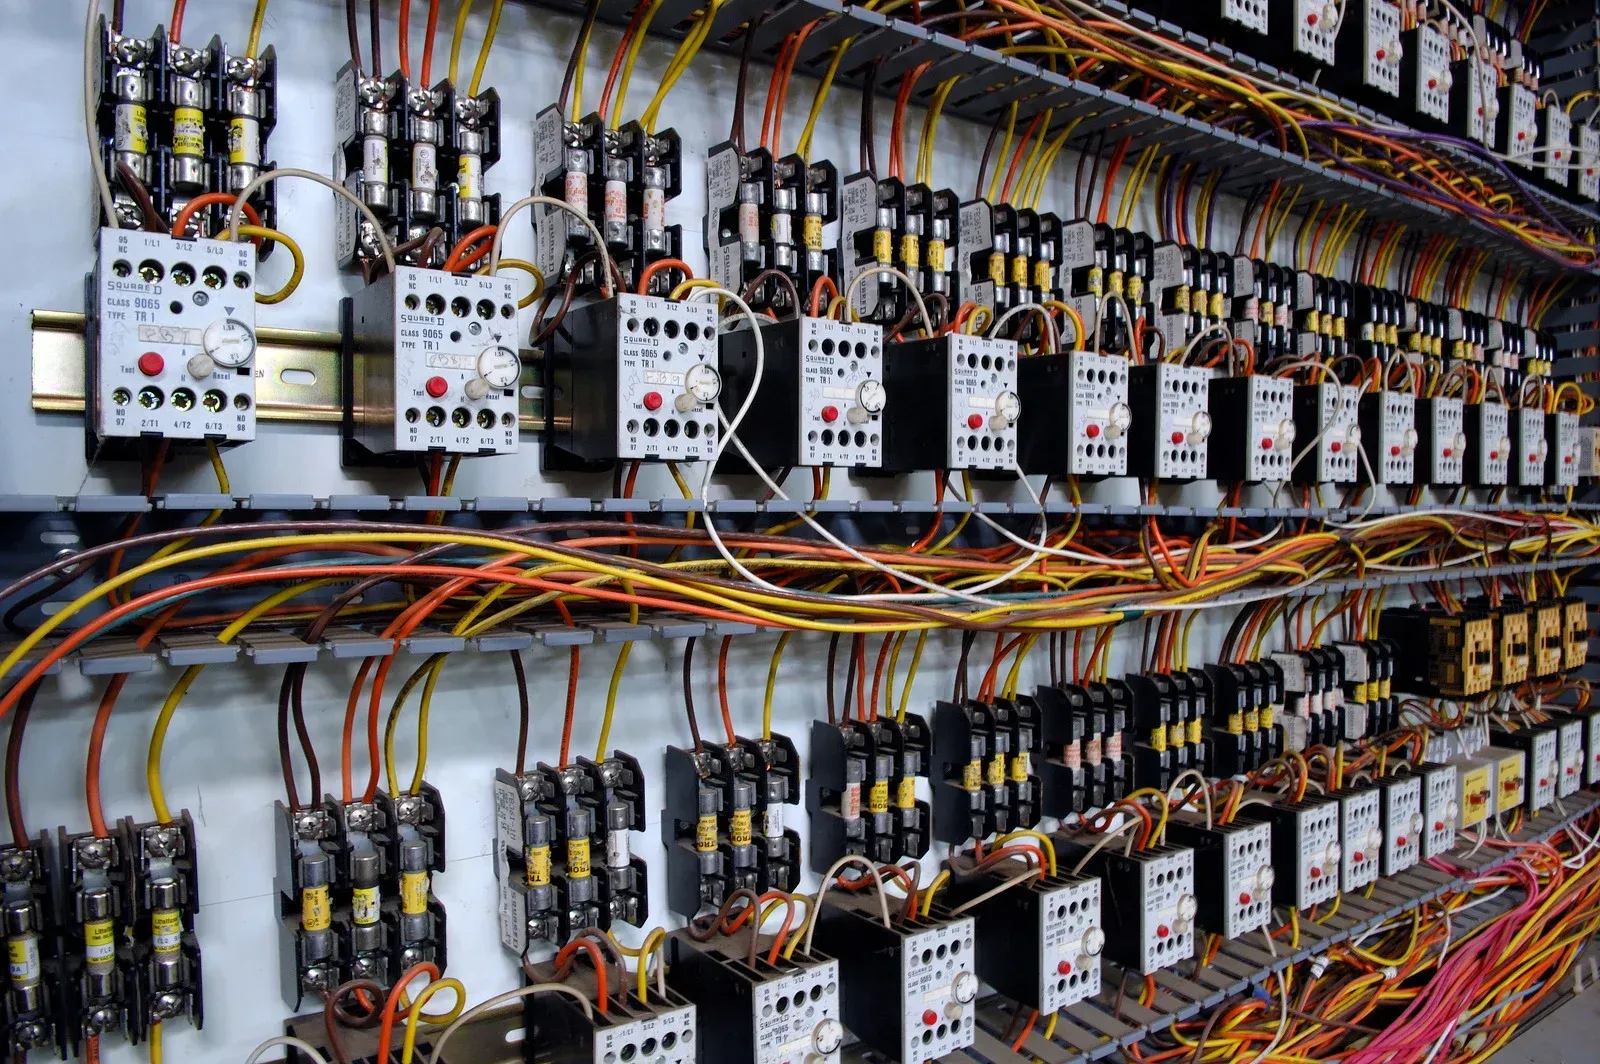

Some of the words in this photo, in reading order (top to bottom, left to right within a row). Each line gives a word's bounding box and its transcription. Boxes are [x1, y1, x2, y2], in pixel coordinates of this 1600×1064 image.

[118, 236, 128, 244] 95
[144, 238, 161, 248] 1/L1
[118, 245, 128, 253] NC
[176, 242, 193, 252] 3/L2
[206, 245, 224, 255] 5/L3
[238, 249, 248, 258] 96
[238, 259, 248, 267] NC
[429, 276, 442, 284] 1/L1
[454, 278, 468, 287] 3/L2
[107, 280, 151, 292] SQUARE
[153, 287, 163, 295] D
[408, 282, 417, 290] NC
[479, 281, 493, 290] 5/L3
[504, 291, 512, 299] NC
[107, 298, 130, 307] CLASS
[134, 297, 160, 310] 9065
[107, 311, 126, 320] TYPE
[135, 311, 147, 321] TR
[400, 314, 435, 325] SQUARE
[436, 318, 445, 326] D
[400, 329, 419, 337] CLASS
[422, 329, 443, 339] 9065
[401, 341, 416, 349] TYPE
[423, 341, 434, 350] TR
[623, 336, 651, 345] SQUARE
[652, 339, 659, 347] D
[640, 349, 658, 358] 9065
[641, 359, 650, 368] TR
[806, 355, 828, 363] SQUARE
[829, 357, 835, 365] D
[120, 366, 135, 374] Test
[819, 366, 834, 375] 9065
[212, 372, 231, 380] Reset
[116, 418, 125, 426] 97
[141, 419, 159, 428] 2/T1
[173, 420, 191, 429] 4/T2
[205, 422, 223, 431] 6/T3
[409, 435, 417, 443] 97
[429, 436, 444, 444] 2/T1
[455, 437, 470, 445] 4/T2
